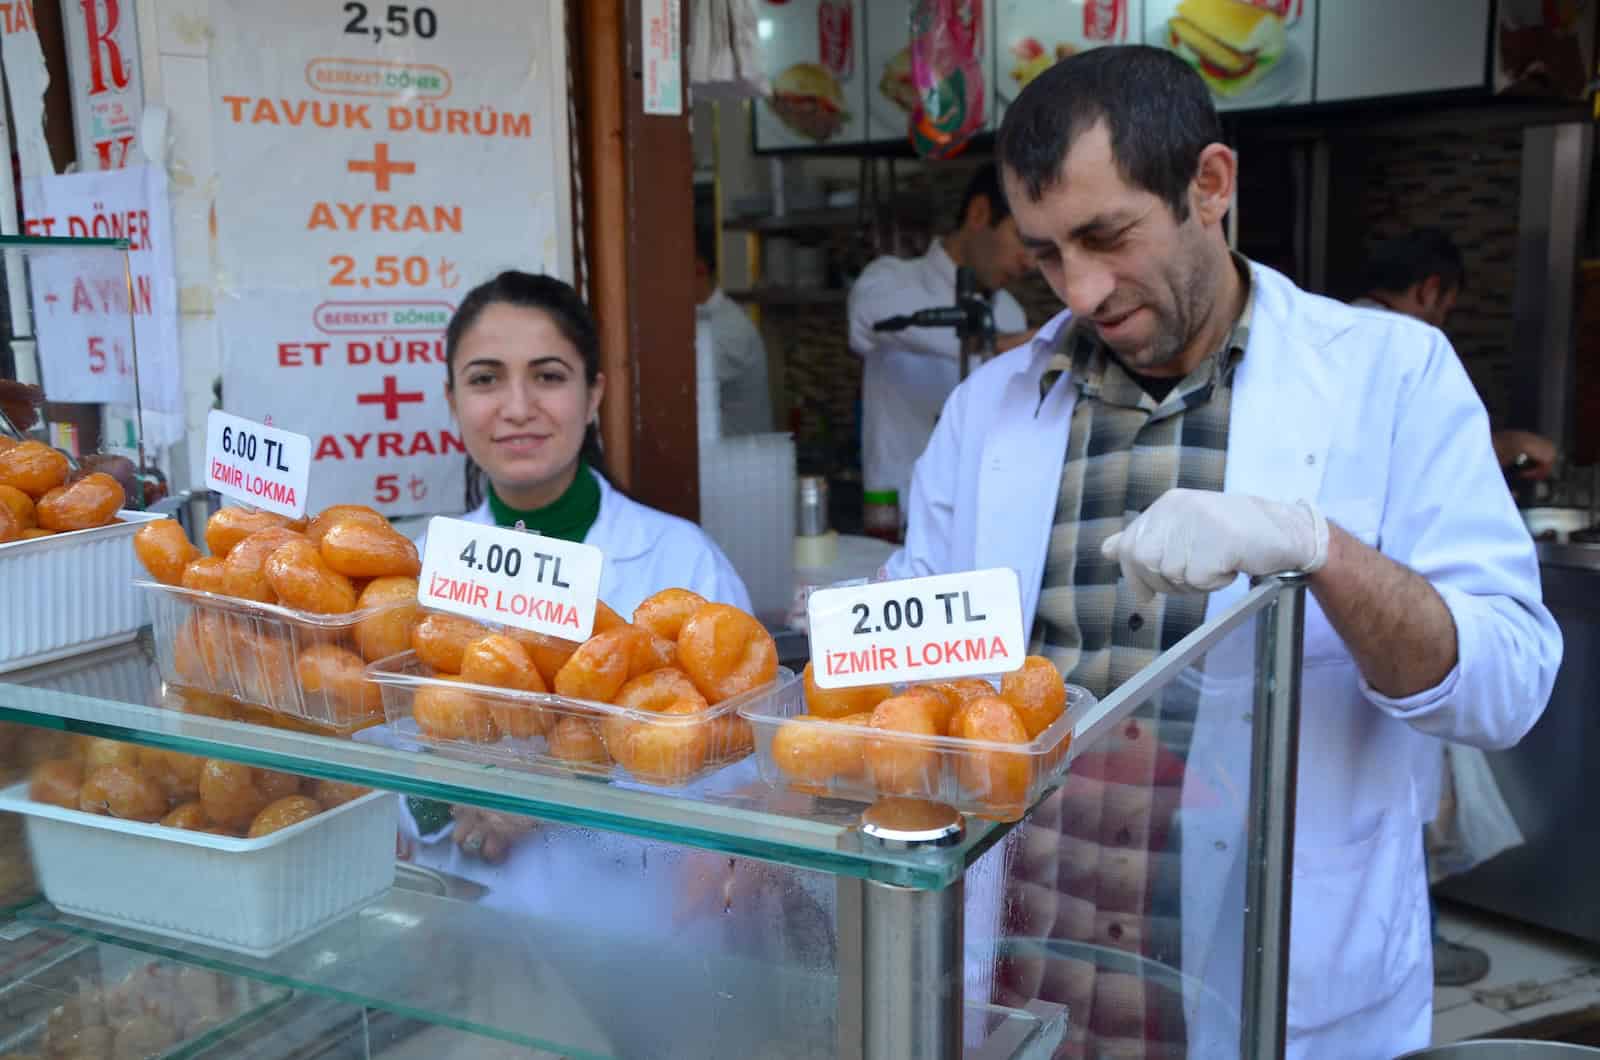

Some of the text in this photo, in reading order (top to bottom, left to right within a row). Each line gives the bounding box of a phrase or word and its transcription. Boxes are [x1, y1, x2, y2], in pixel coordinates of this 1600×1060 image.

[343, 1, 438, 43] 2,50
[222, 95, 532, 137] TAVUK DÜRÜM
[68, 202, 152, 251] DÖNER
[307, 201, 463, 233] AYRAN
[329, 255, 429, 289] 2,50
[324, 308, 448, 326] BEREKET DÖNER
[278, 341, 331, 367] ET
[222, 426, 289, 472] 6.00 TL
[314, 430, 466, 461] AYRAN
[211, 457, 297, 507] İZMİR LOKMA
[375, 475, 399, 503] 5
[459, 539, 570, 589] 4.00 TL
[429, 571, 580, 629] İZMİR LOKMA
[851, 590, 987, 635] 2.00 TL
[826, 635, 1009, 676] İZMİR LOKMA
